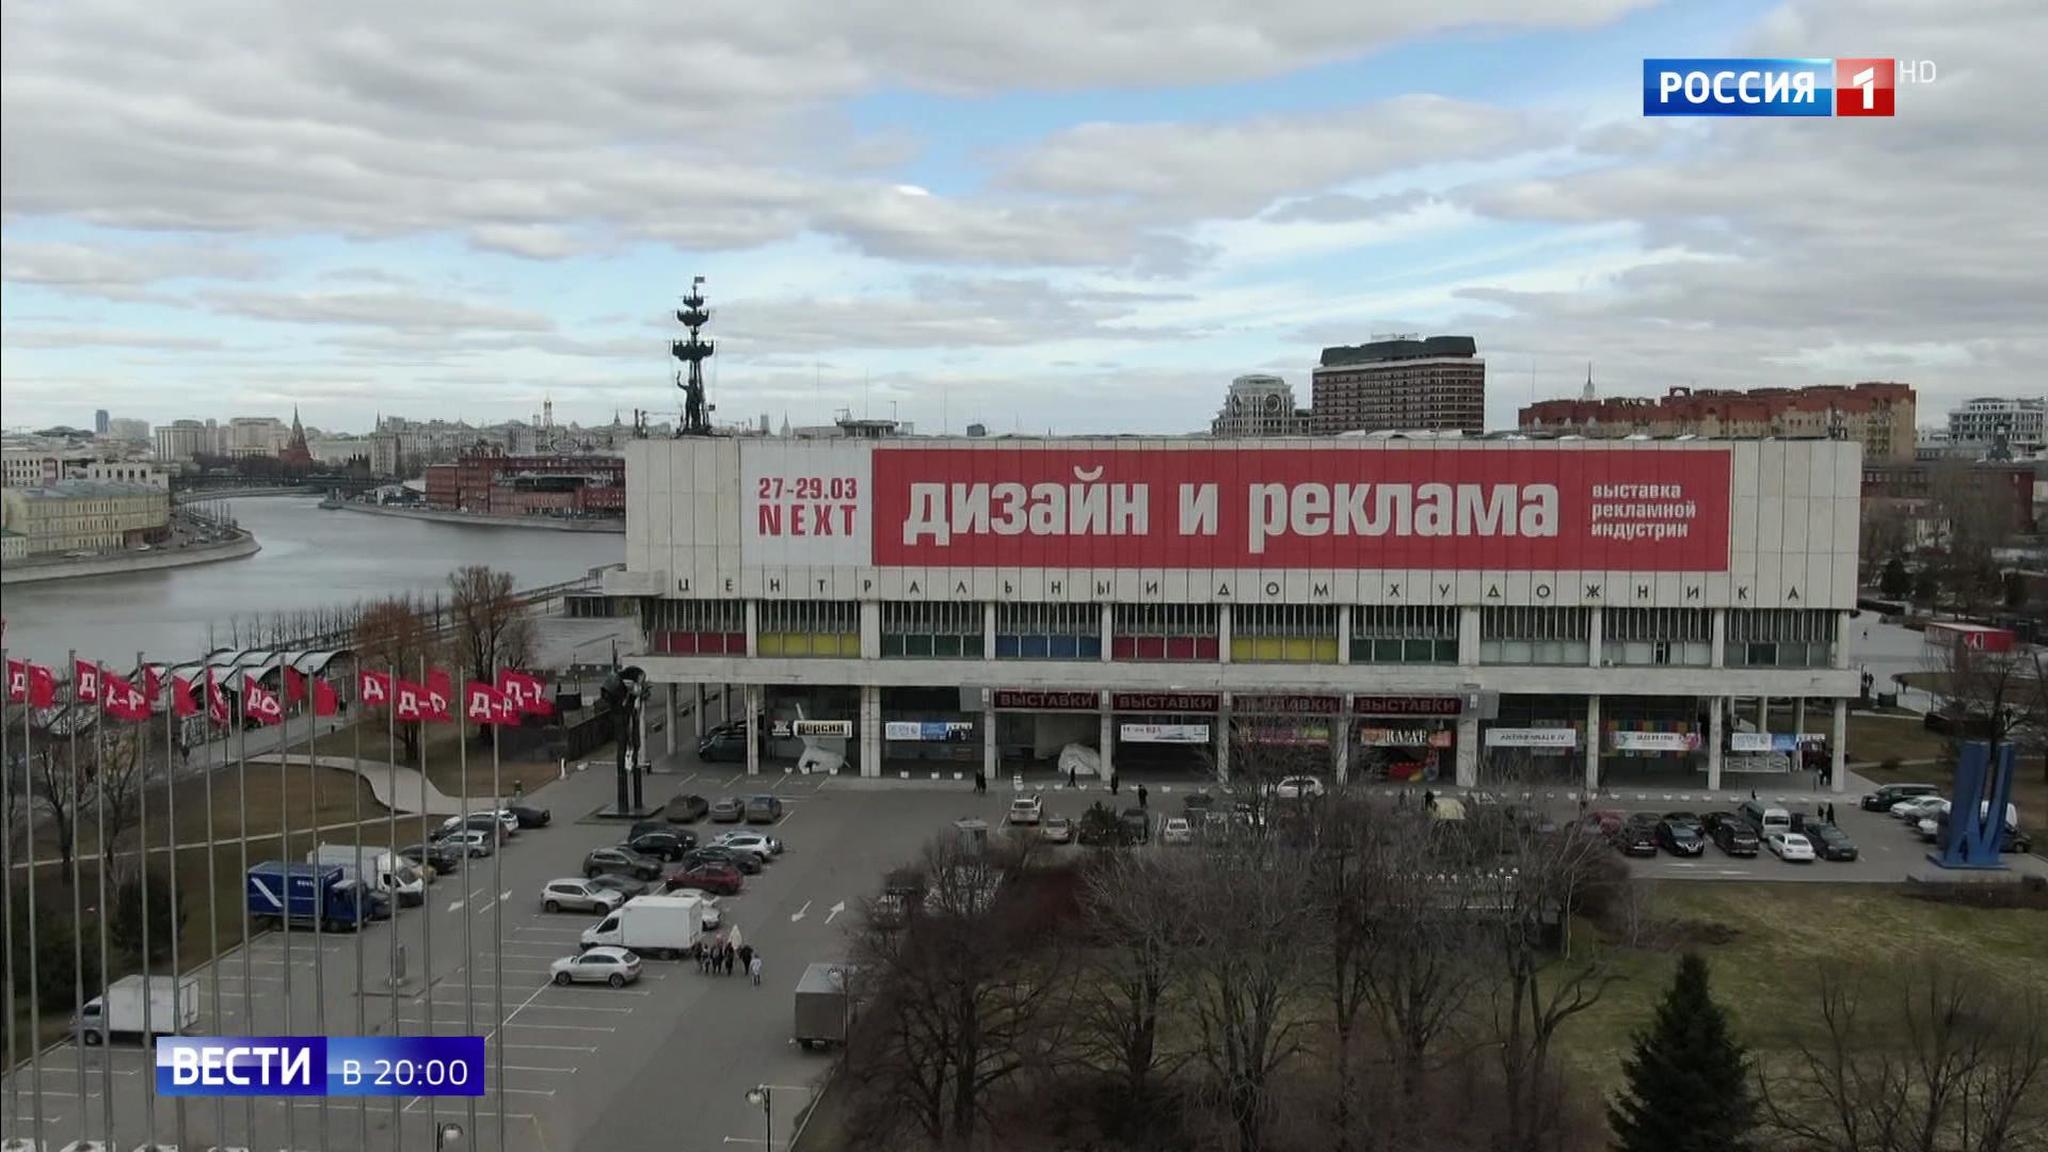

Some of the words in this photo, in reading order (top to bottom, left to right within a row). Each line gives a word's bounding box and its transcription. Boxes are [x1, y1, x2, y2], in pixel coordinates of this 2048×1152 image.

[759, 477, 857, 499] 27-29.03
[1592, 484, 1681, 499] выставка
[903, 465, 1149, 546] дизайн
[1179, 484, 1217, 536] и
[1248, 482, 1559, 553] реклама
[1591, 500, 1697, 521] рекламной
[759, 504, 857, 536] NEXT
[1591, 523, 1688, 542] индустрии
[1218, 582, 1329, 597] ДОМ
[1389, 583, 1799, 601] ХУДОЖНИКА
[79, 673, 97, 698] Д
[363, 675, 385, 700] Д
[1000, 694, 1092, 706] ВЫСТАВКИ
[1119, 696, 1212, 708] ВЫСТАВКИ
[1359, 699, 1455, 711] ВЫСТАВКИ
